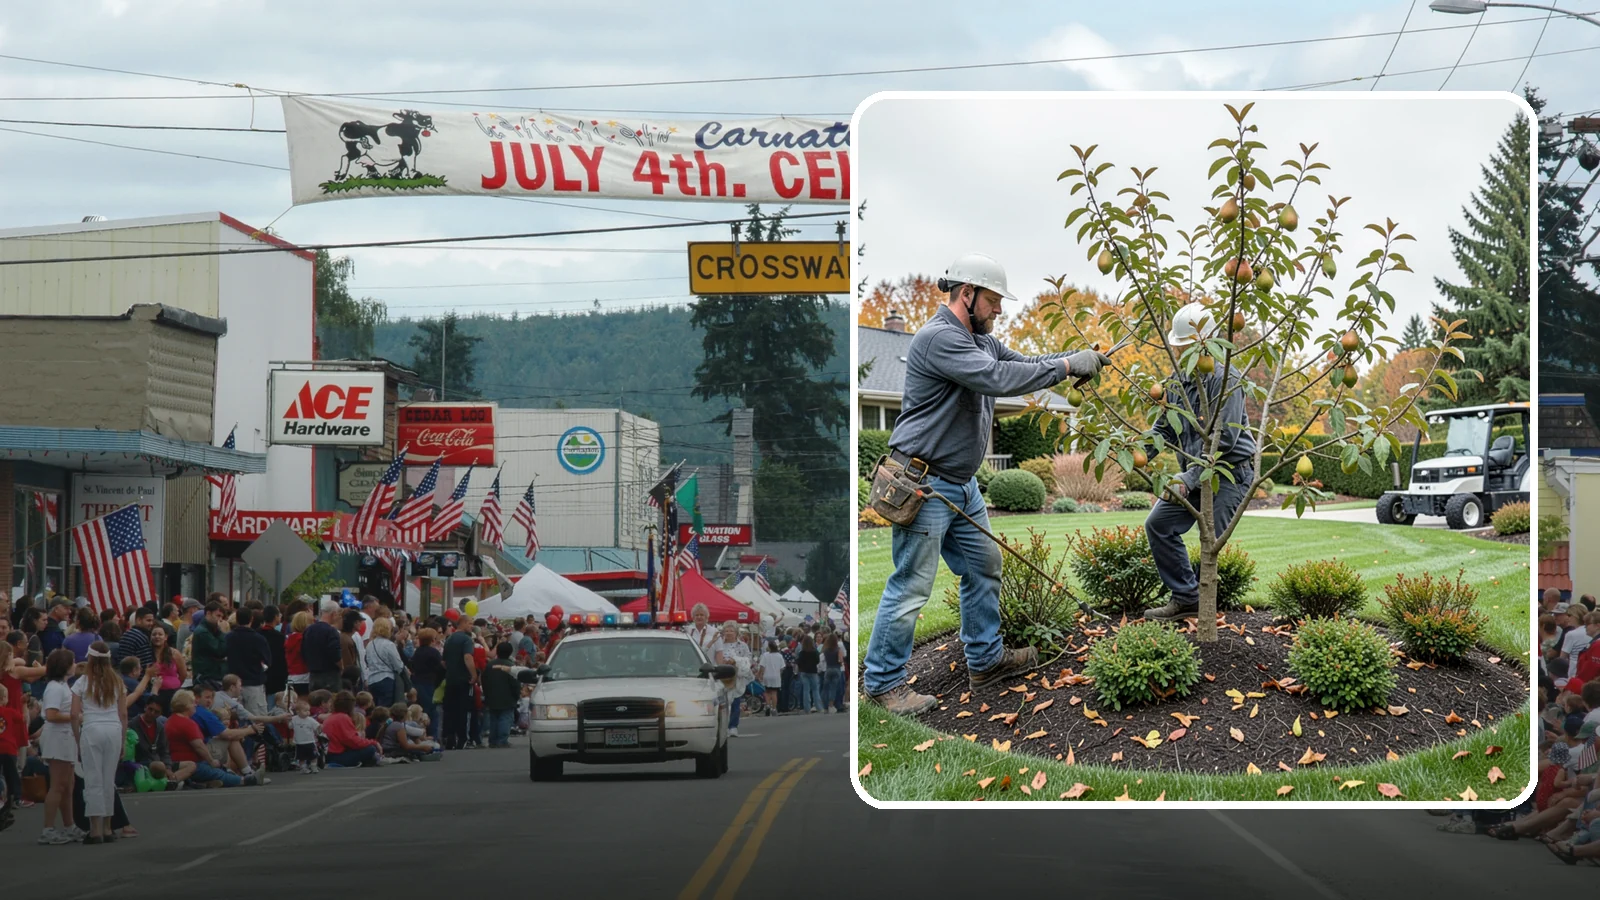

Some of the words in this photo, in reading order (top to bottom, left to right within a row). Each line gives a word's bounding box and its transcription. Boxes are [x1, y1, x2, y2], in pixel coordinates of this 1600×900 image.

[481, 141, 605, 192] JULY
[632, 149, 747, 197] 4th.
[697, 254, 850, 280] CROSSWA
[283, 380, 373, 419] ACE
[406, 409, 453, 422] CEDAR
[284, 421, 370, 436] Hardware
[96, 485, 124, 494] Vincent
[126, 486, 136, 494] de
[138, 486, 155, 495] Paul
[81, 503, 154, 522] THT
[688, 526, 741, 535] CRNATION
[699, 535, 730, 543] GLASS
